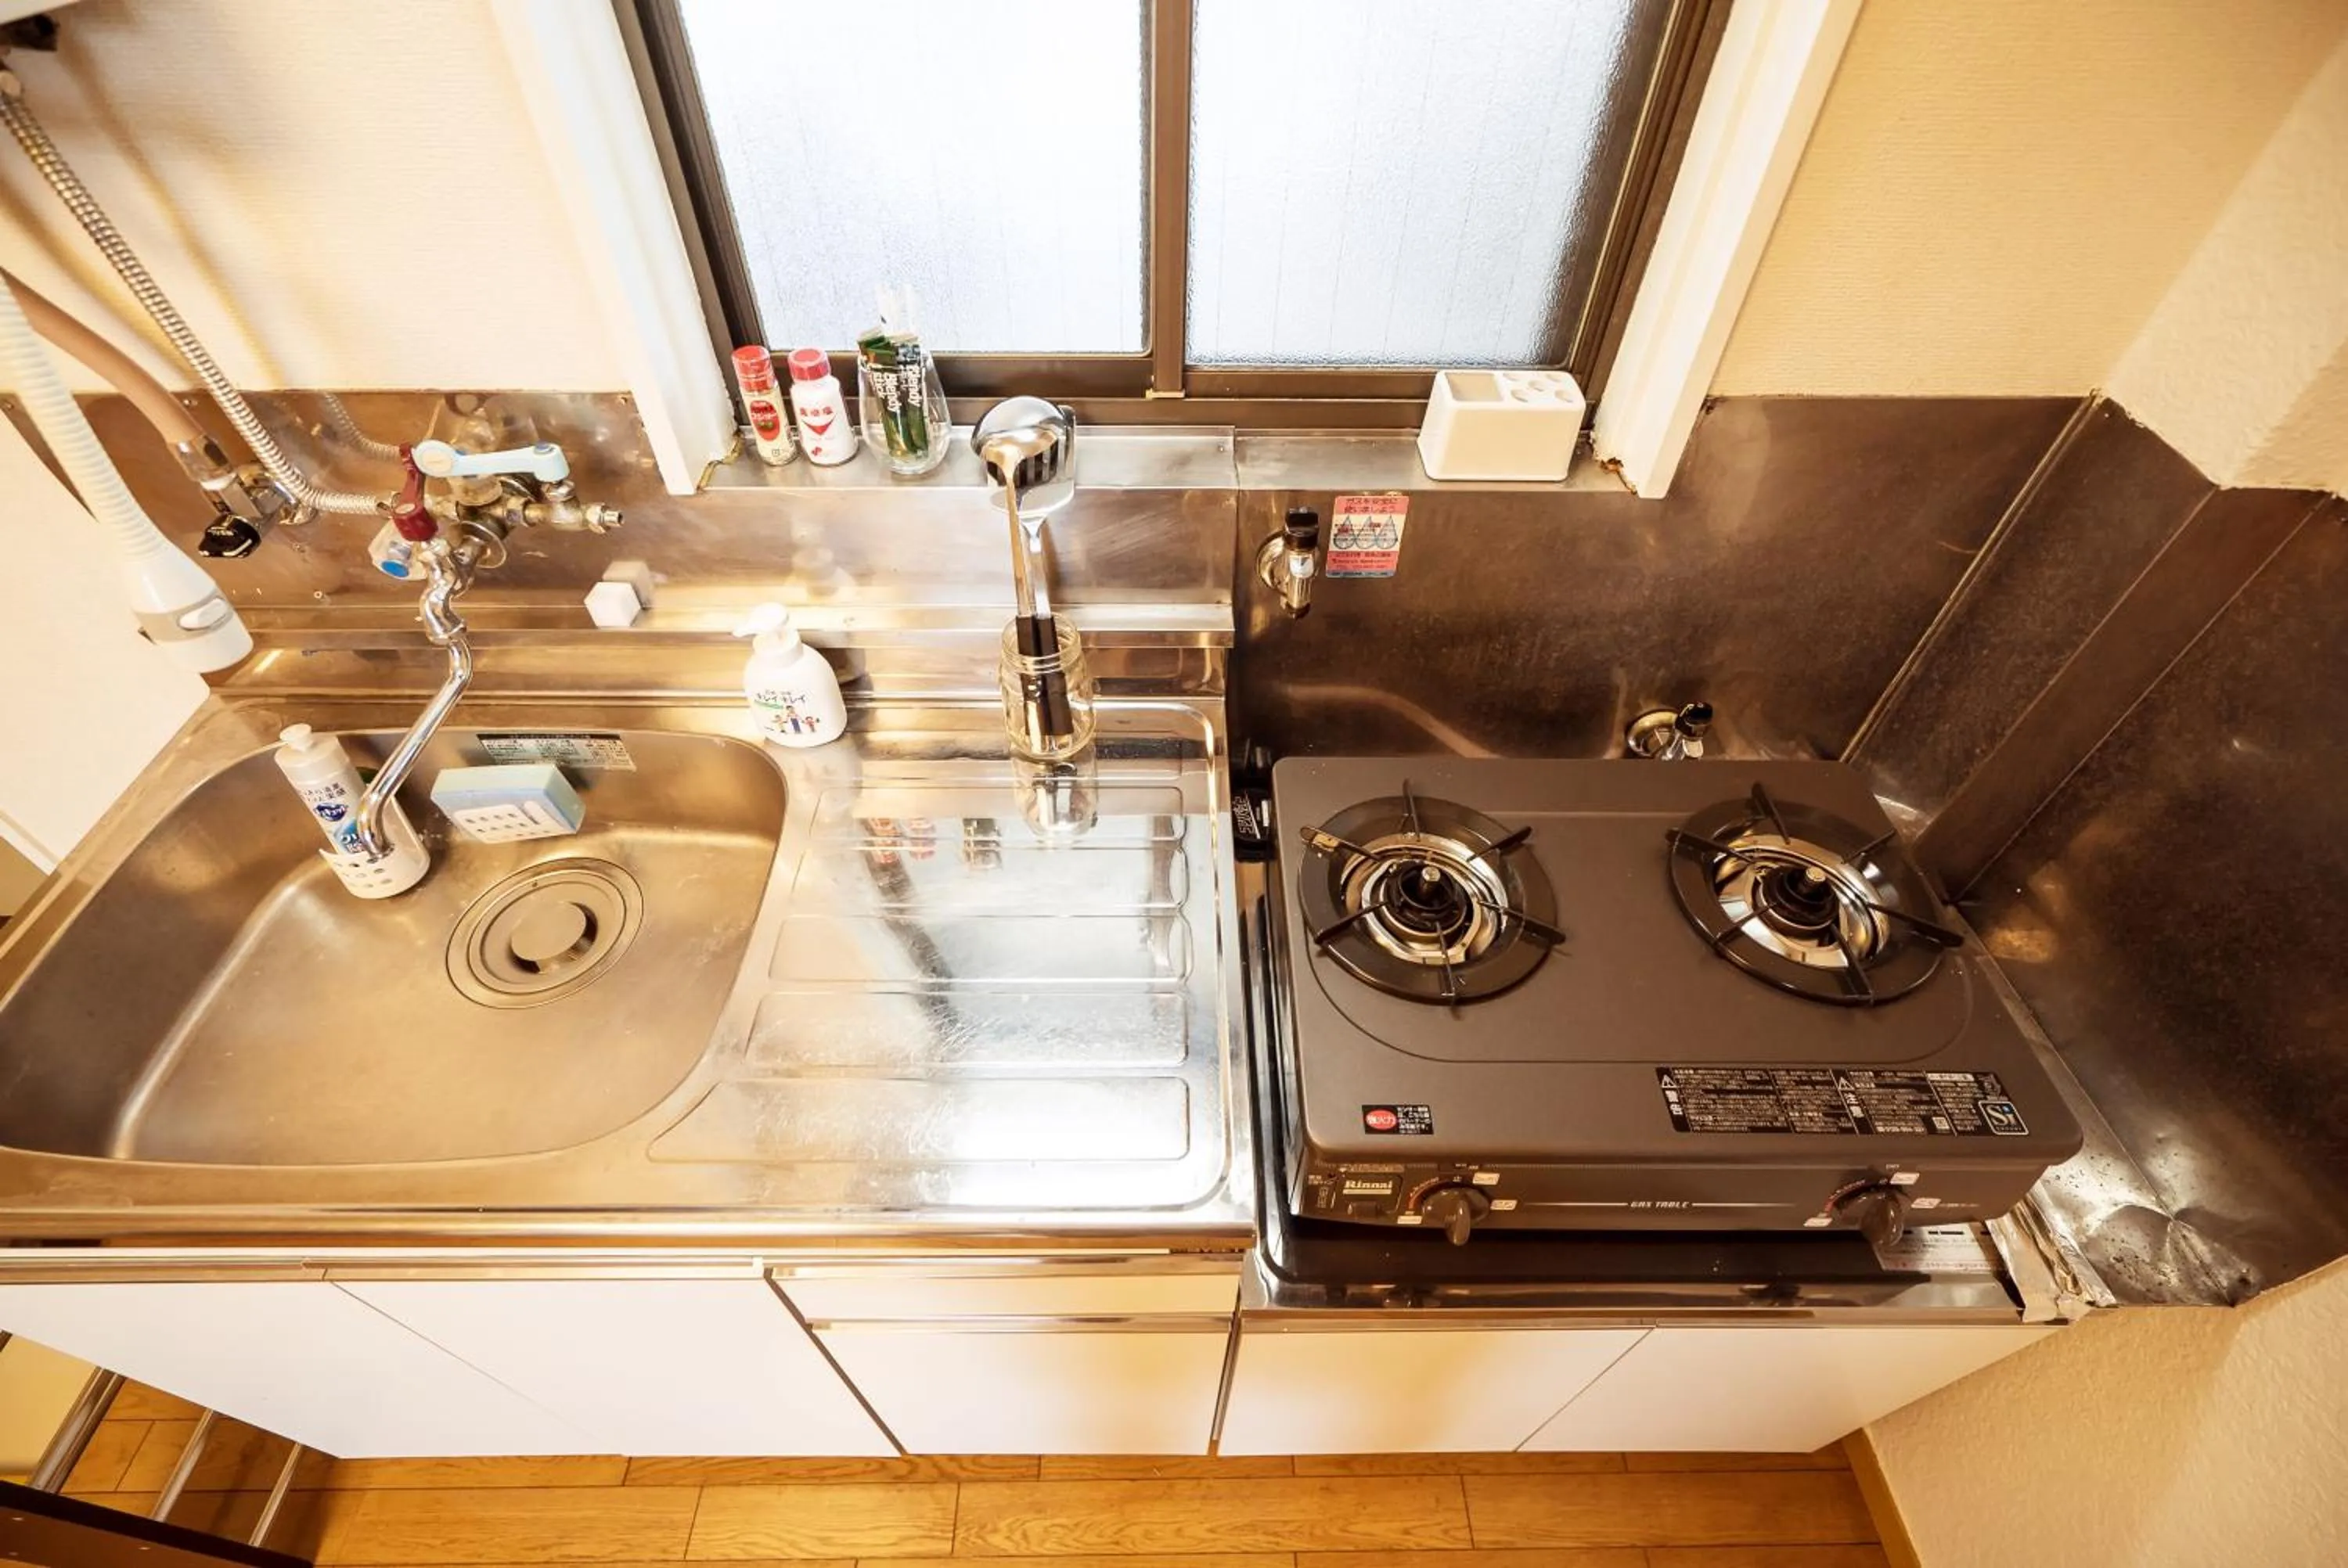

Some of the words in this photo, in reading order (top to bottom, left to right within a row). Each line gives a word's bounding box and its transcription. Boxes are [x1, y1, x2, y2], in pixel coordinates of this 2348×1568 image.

[884, 372, 902, 412] Blendy
[906, 365, 923, 407] Blendy
[1986, 1104, 2017, 1125] Si
[1344, 1179, 1393, 1189] Rinnai
